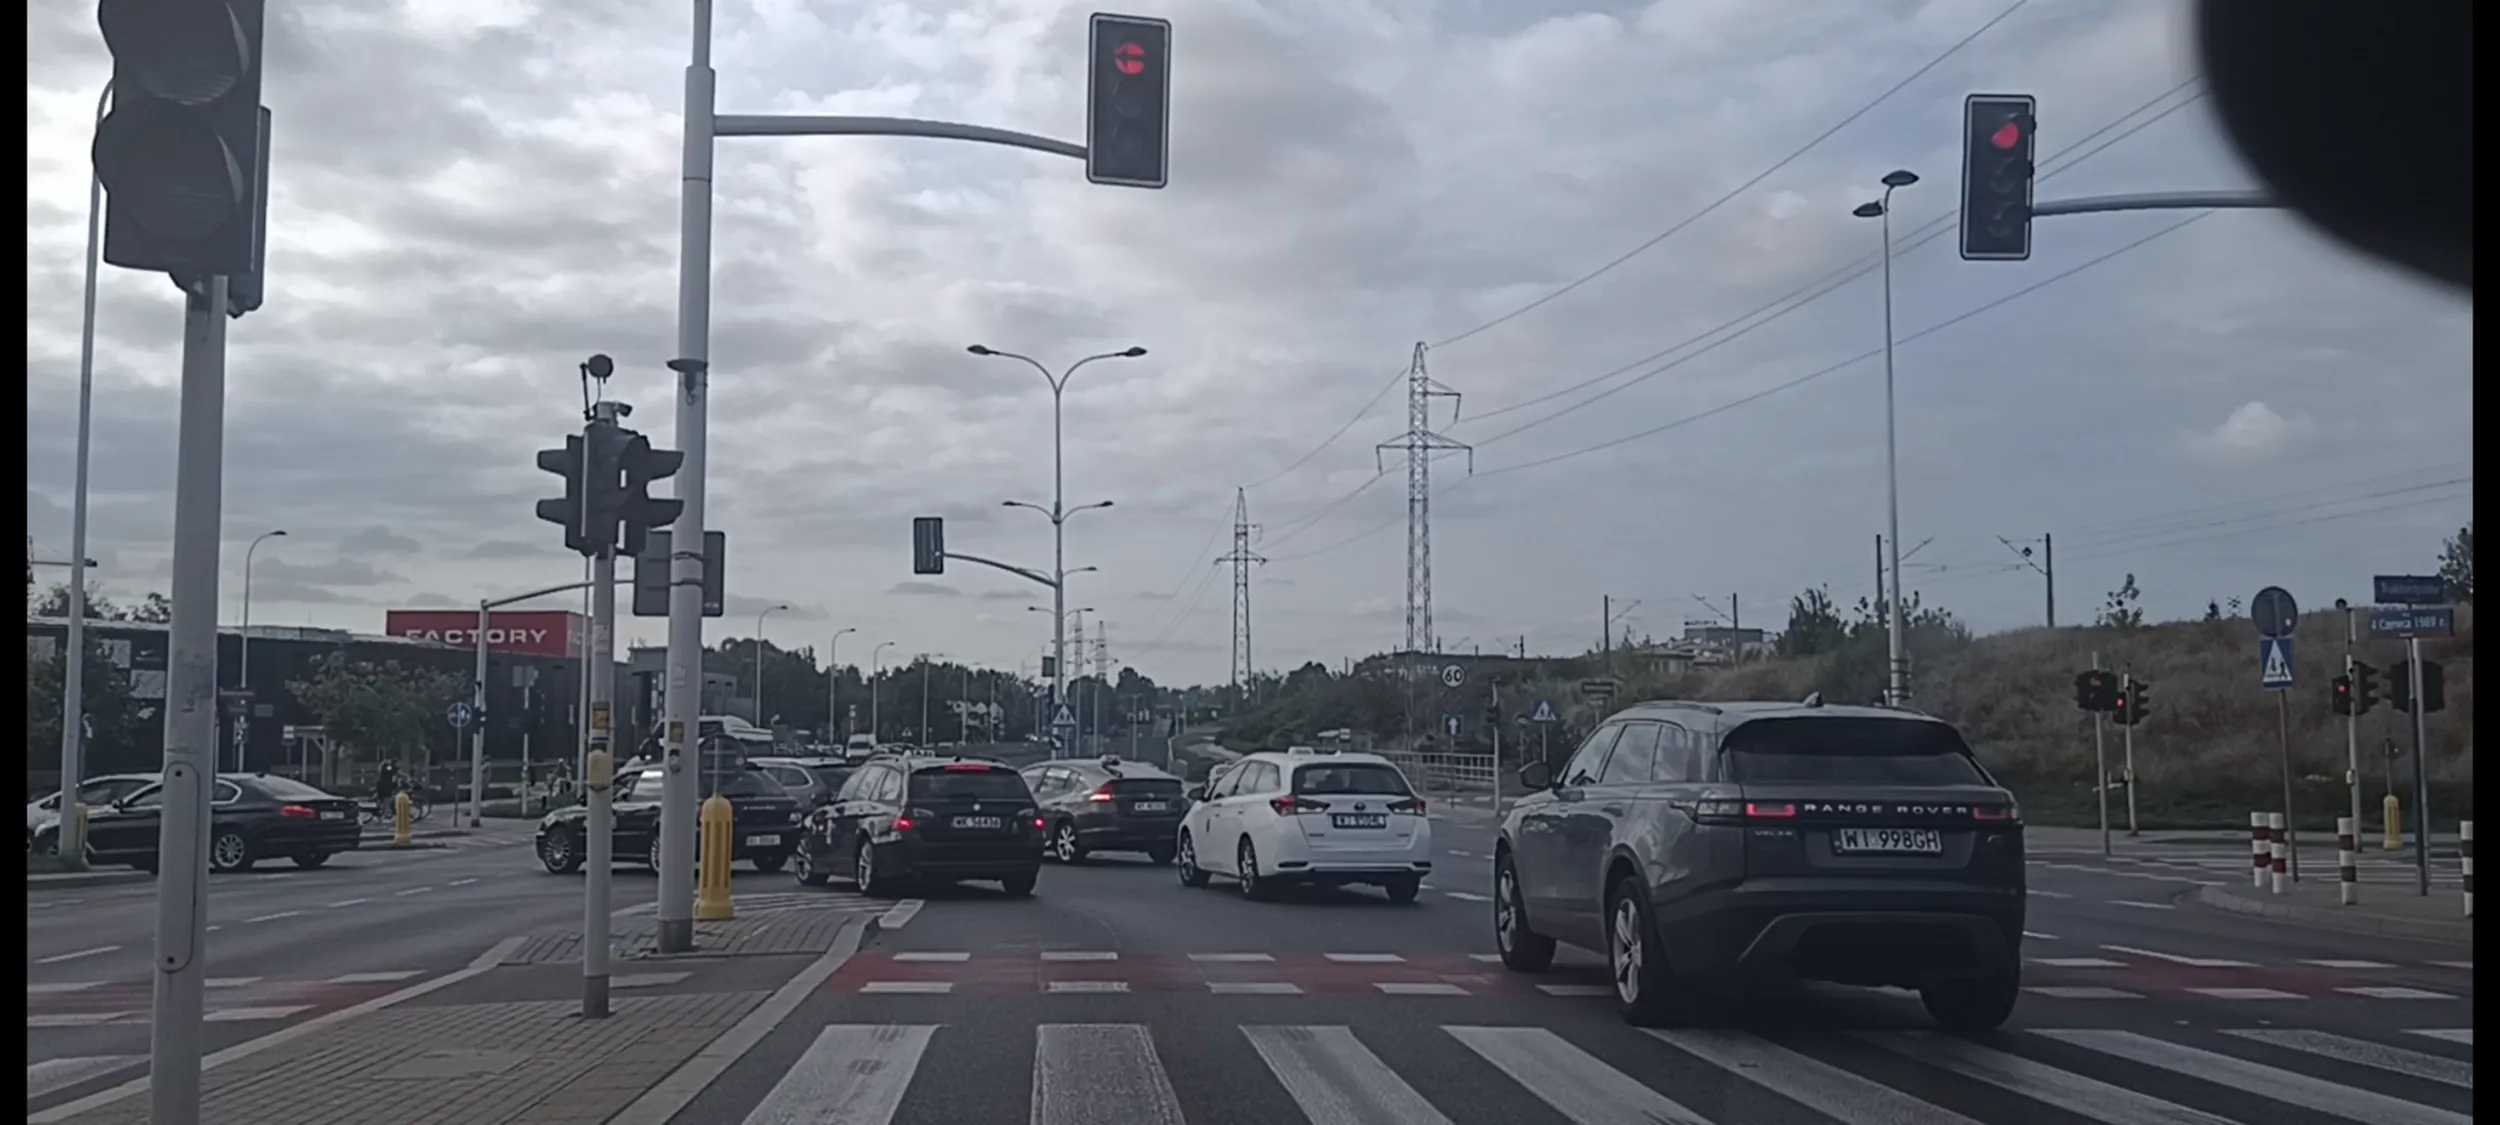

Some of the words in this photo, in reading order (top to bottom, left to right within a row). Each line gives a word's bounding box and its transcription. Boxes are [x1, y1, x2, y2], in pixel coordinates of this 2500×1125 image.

[405, 629, 548, 645] FACTORY
[1445, 669, 1463, 683] 60
[1805, 803, 1882, 813] RANGE
[1896, 805, 1968, 815] ROVER
[1845, 830, 1869, 849] WI
[1880, 831, 1940, 851] 998GH
